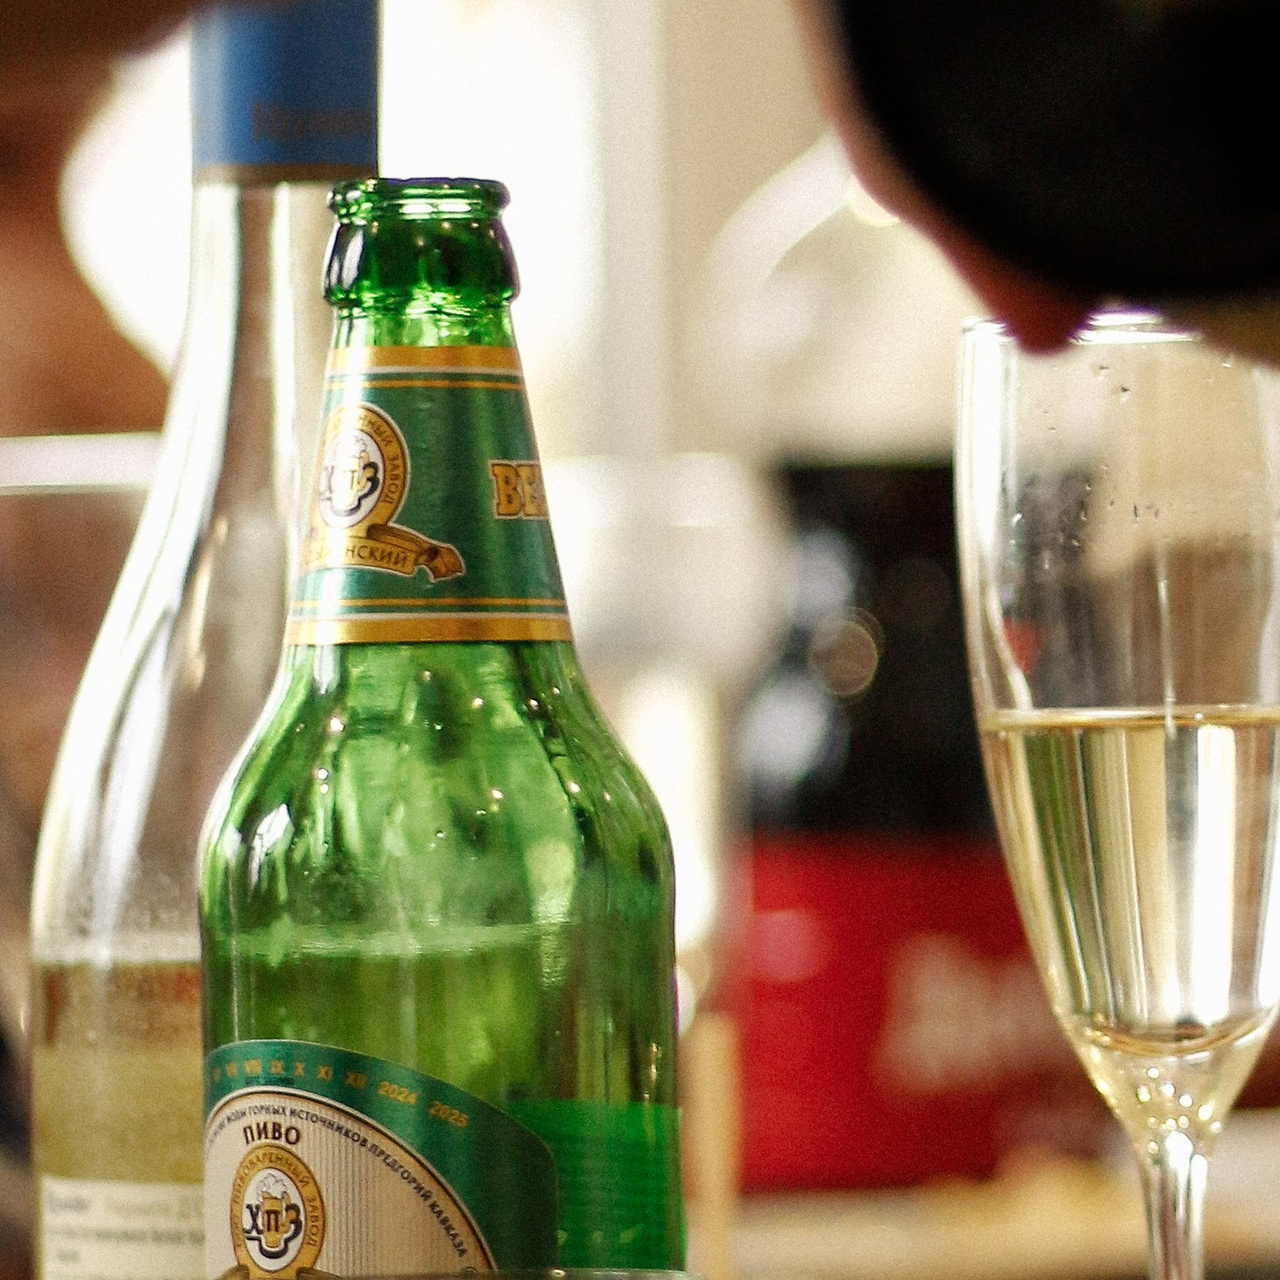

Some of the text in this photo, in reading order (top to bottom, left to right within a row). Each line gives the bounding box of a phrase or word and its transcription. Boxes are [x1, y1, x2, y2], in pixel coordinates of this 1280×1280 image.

[243, 1121, 301, 1145] ПИВО
[248, 1104, 286, 1118] ГОРНЫХ
[289, 1106, 369, 1148] ИСТОЧНИКОВ
[367, 1143, 433, 1202] ПРЕДГОРИЙ
[428, 1200, 467, 1258] КАВКАЗА
[305, 1195, 320, 1248] ЗАВОД
